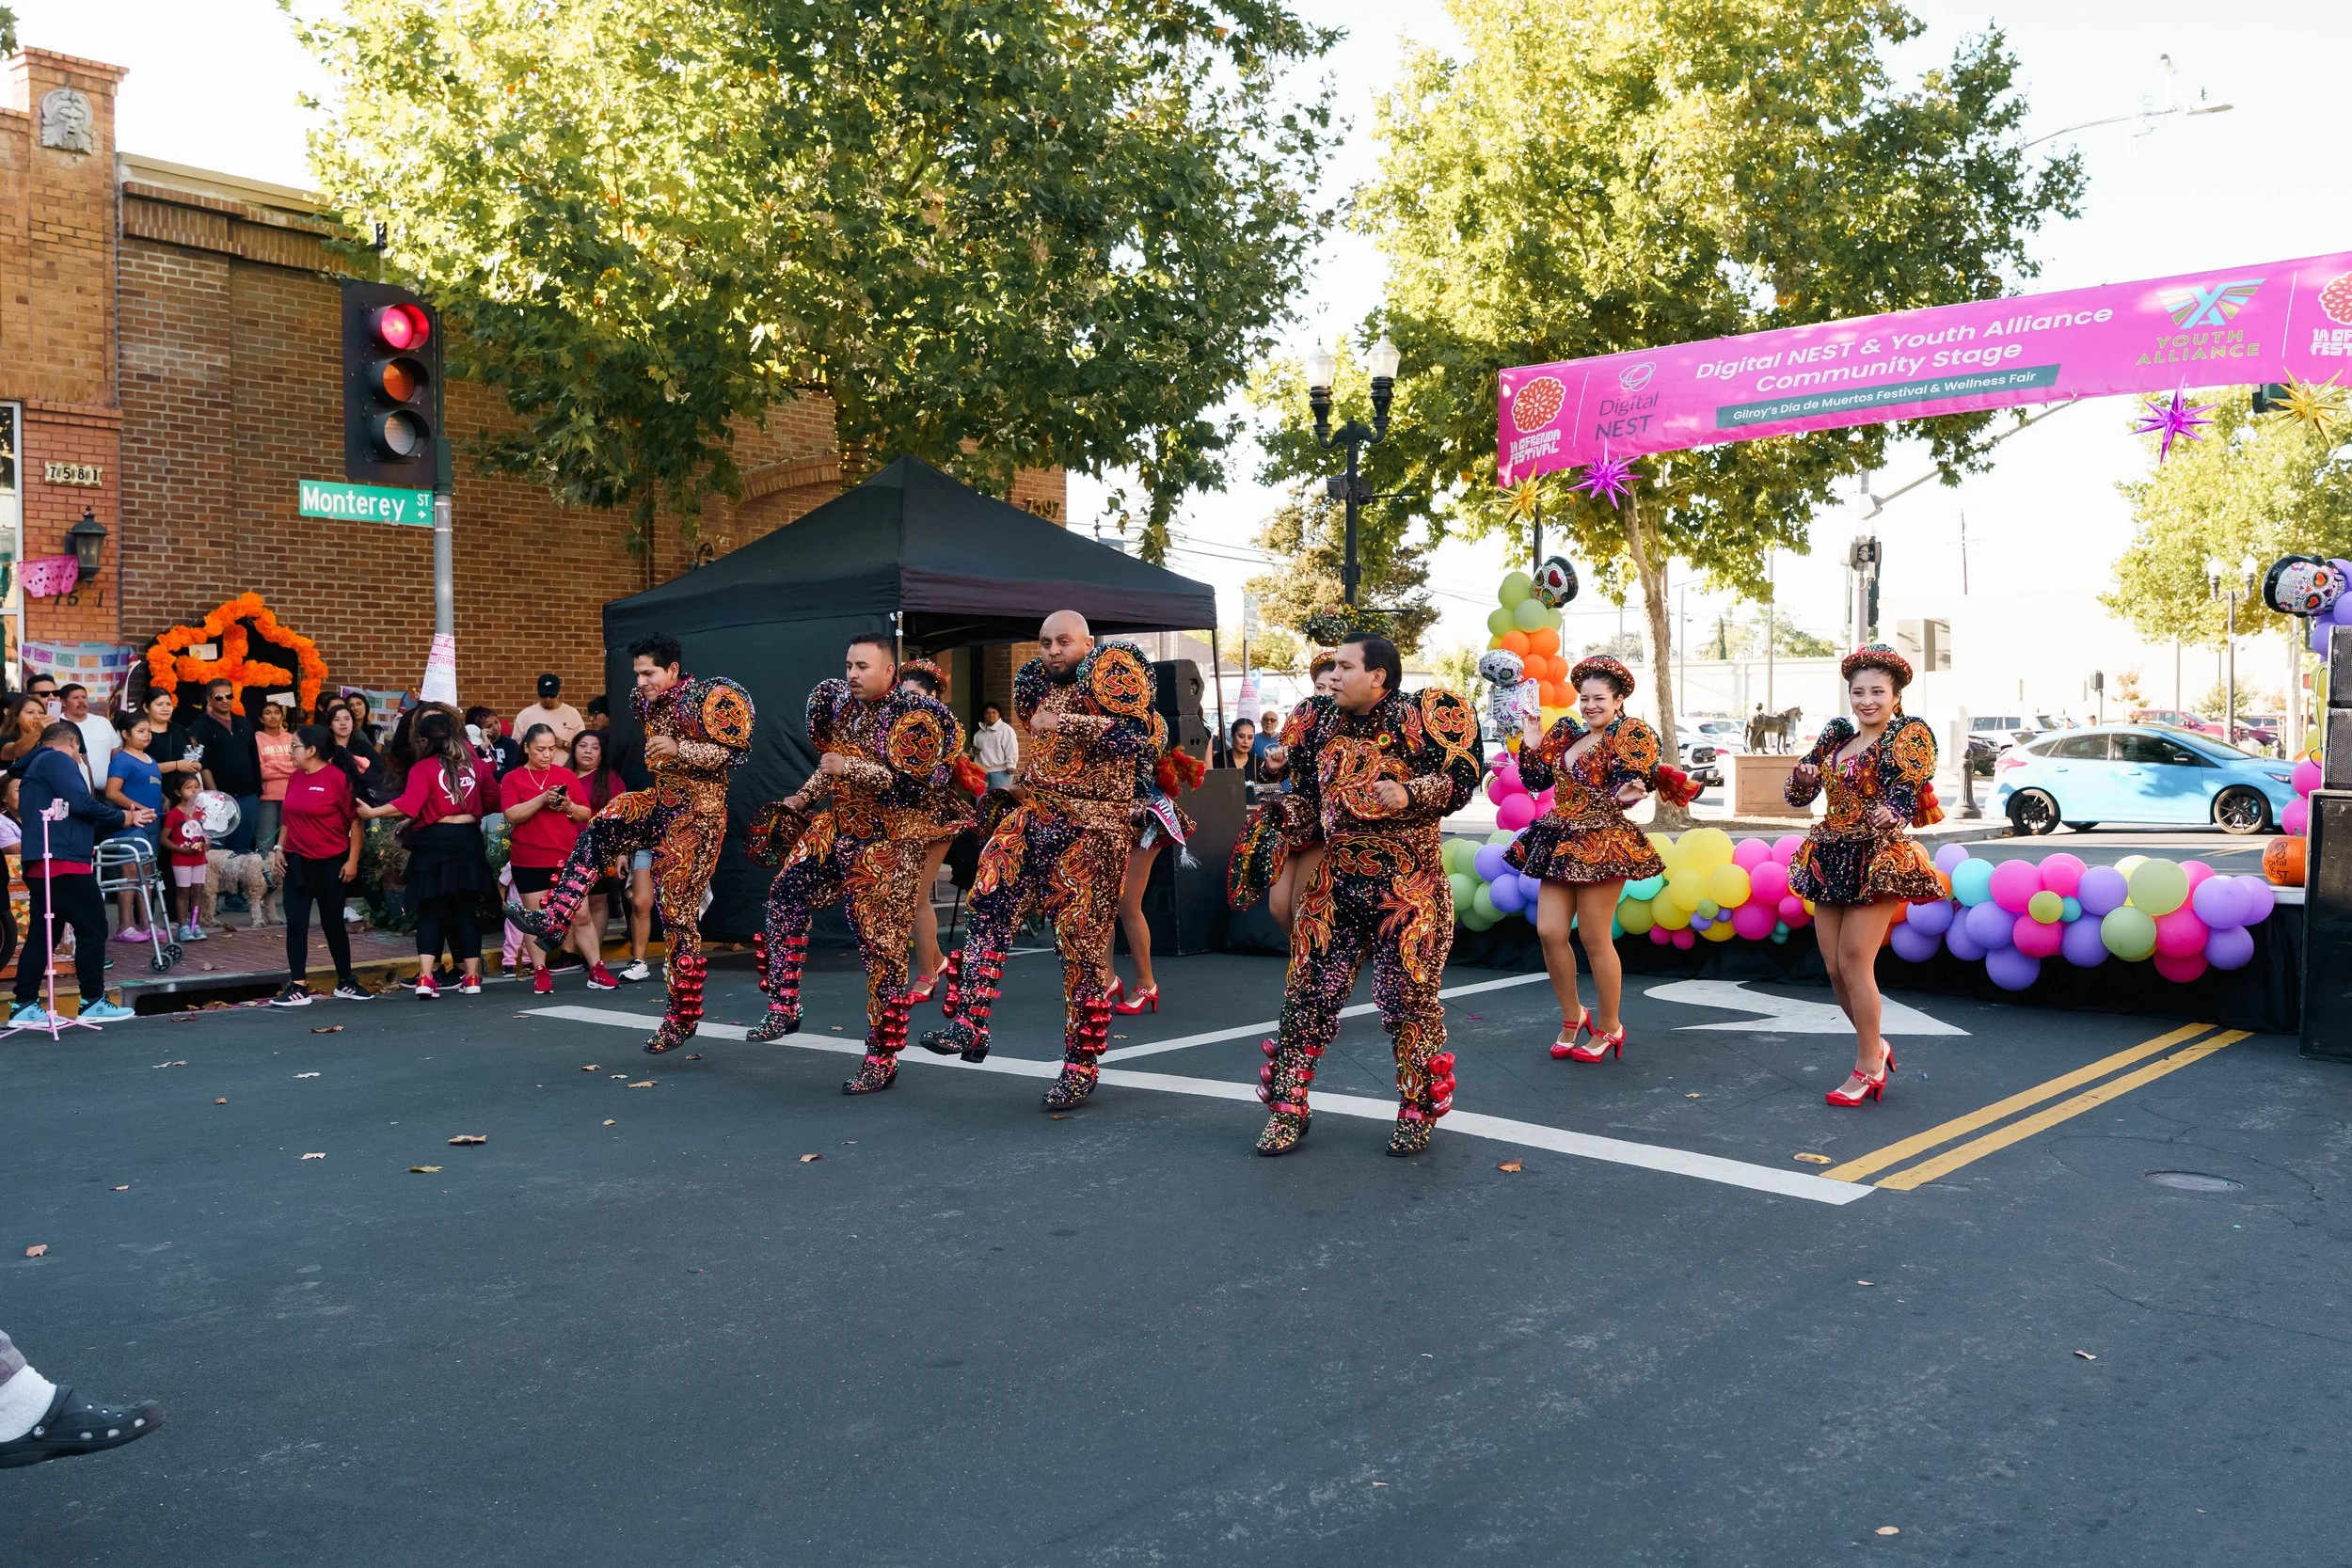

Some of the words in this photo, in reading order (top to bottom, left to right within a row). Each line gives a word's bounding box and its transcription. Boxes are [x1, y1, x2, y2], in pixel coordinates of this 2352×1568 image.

[1696, 352, 1782, 380] Digital
[1788, 341, 1855, 365] NEST
[1860, 339, 1882, 355] &
[1891, 325, 1976, 350] Youth
[1982, 309, 2113, 338] Alliance
[2156, 329, 2244, 349] YOUTH
[2136, 343, 2260, 366] ALLIANCE
[1756, 355, 1926, 392] Community
[1932, 344, 2023, 368] Stage
[1599, 391, 1659, 417] Digital
[1780, 404, 1801, 414] Día
[1804, 400, 1819, 410] de
[1821, 393, 1873, 407] Muertos
[1876, 385, 1928, 402] Festival
[1930, 384, 1941, 393] &
[1945, 376, 2006, 391] Wellness
[2009, 372, 2037, 385] Fair
[1596, 415, 1653, 440] NEST
[1510, 441, 1560, 465] FESTIVAL
[50, 467, 97, 481] 7581
[302, 485, 405, 521] Monterey
[417, 493, 430, 507] ST
